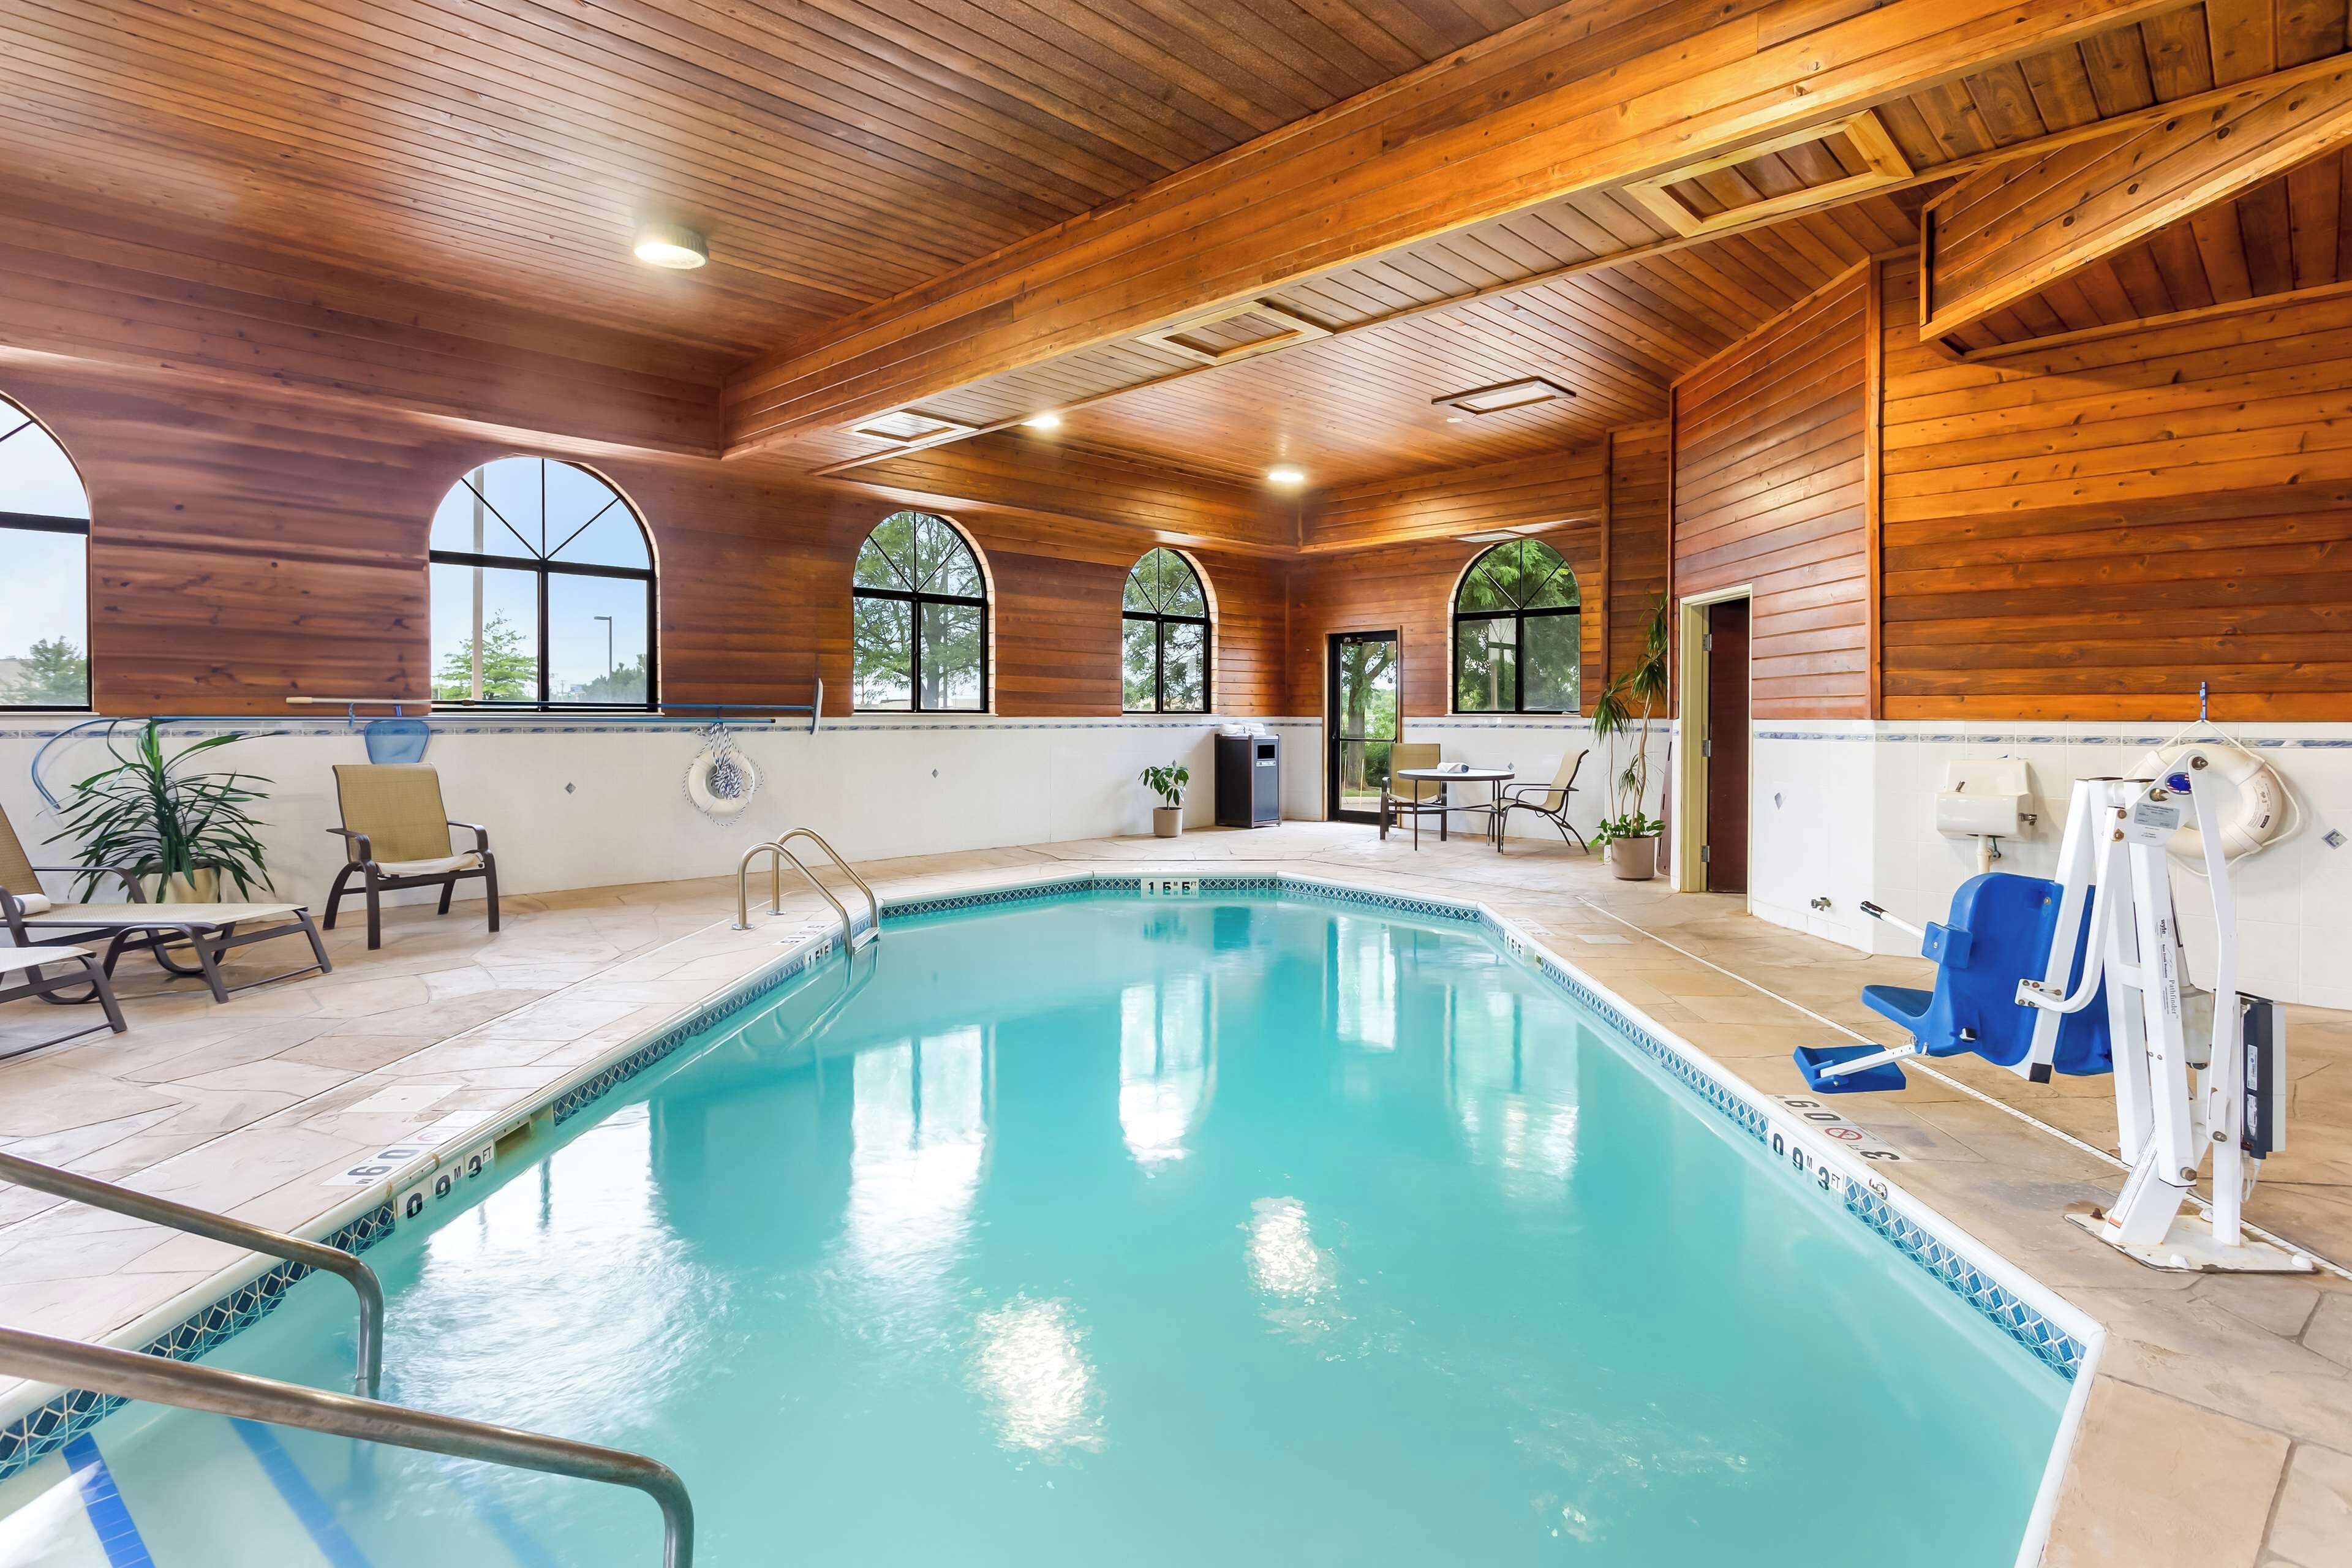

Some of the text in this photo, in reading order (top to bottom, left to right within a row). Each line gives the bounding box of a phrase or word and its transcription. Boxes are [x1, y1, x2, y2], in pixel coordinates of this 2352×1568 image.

[454, 1165, 461, 1181] M
[468, 1155, 483, 1178] 3
[483, 1146, 492, 1162] FT
[1806, 1155, 1812, 1170] M
[1831, 1173, 1840, 1190] FT
